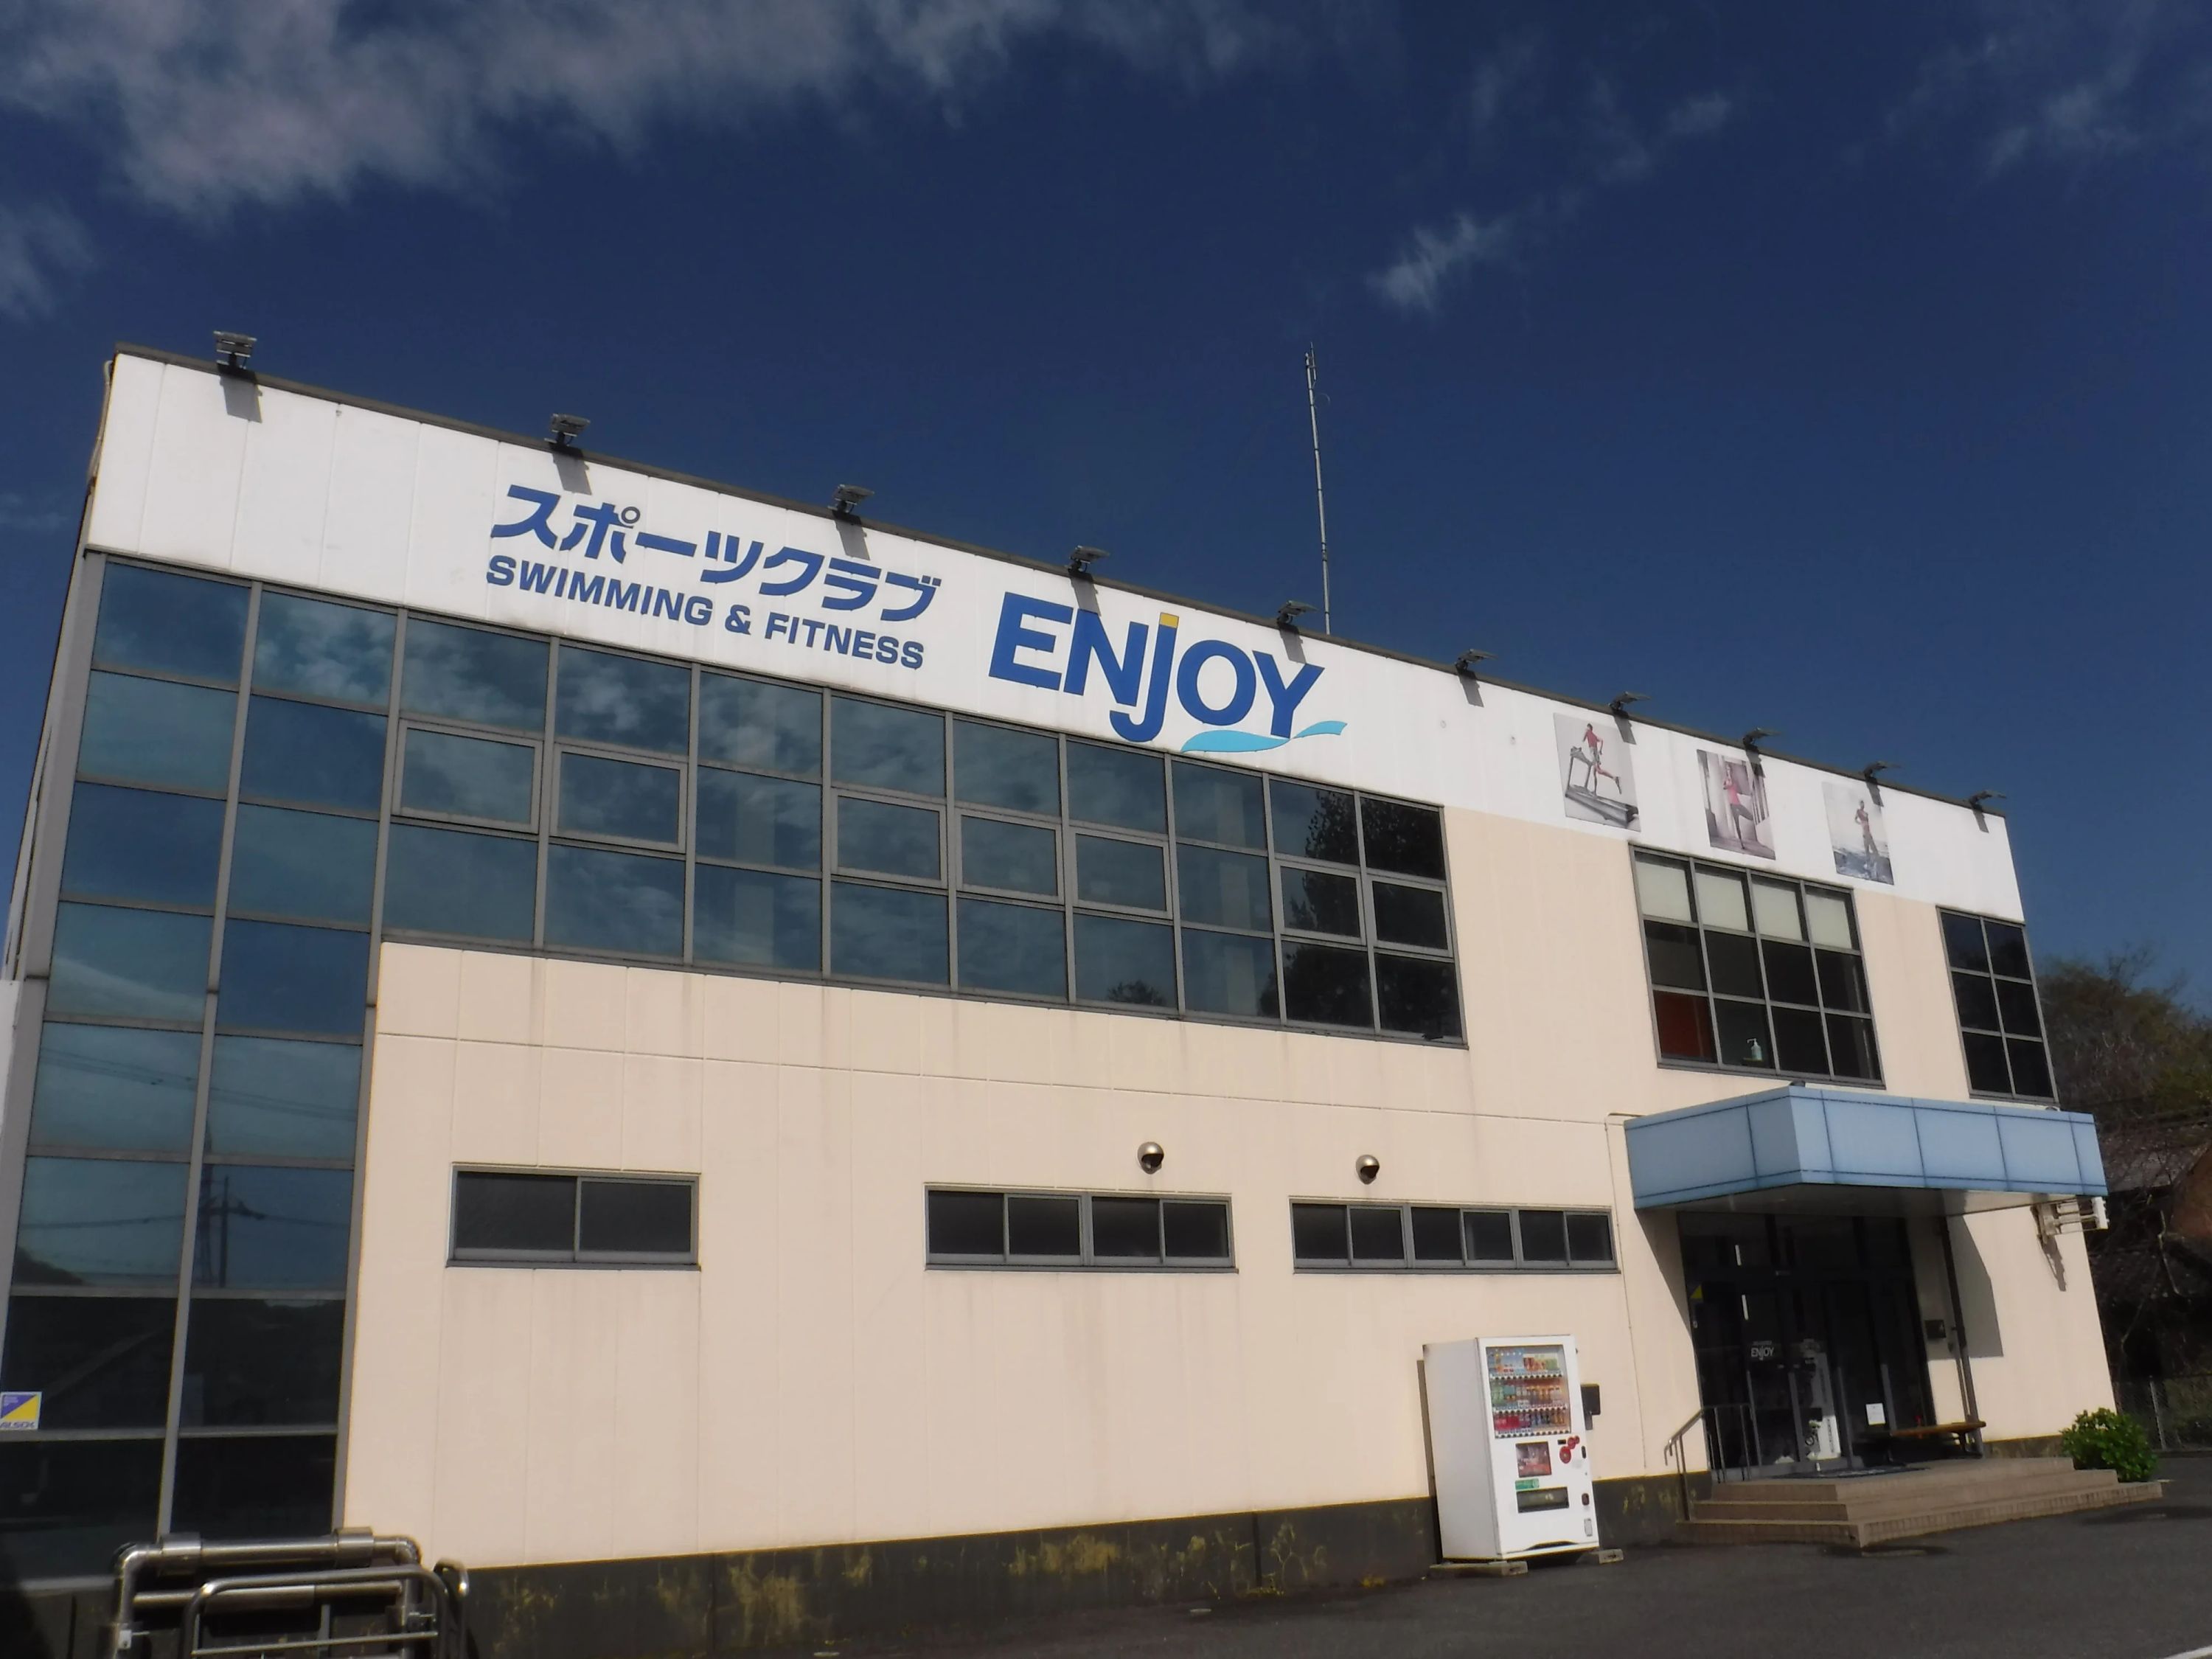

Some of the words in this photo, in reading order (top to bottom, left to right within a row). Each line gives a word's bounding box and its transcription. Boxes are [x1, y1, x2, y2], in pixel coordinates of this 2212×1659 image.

[487, 555, 713, 626] SWIMMING
[724, 604, 751, 636] &
[765, 612, 924, 669] FITNESS
[490, 484, 941, 622] スポーツクラブ
